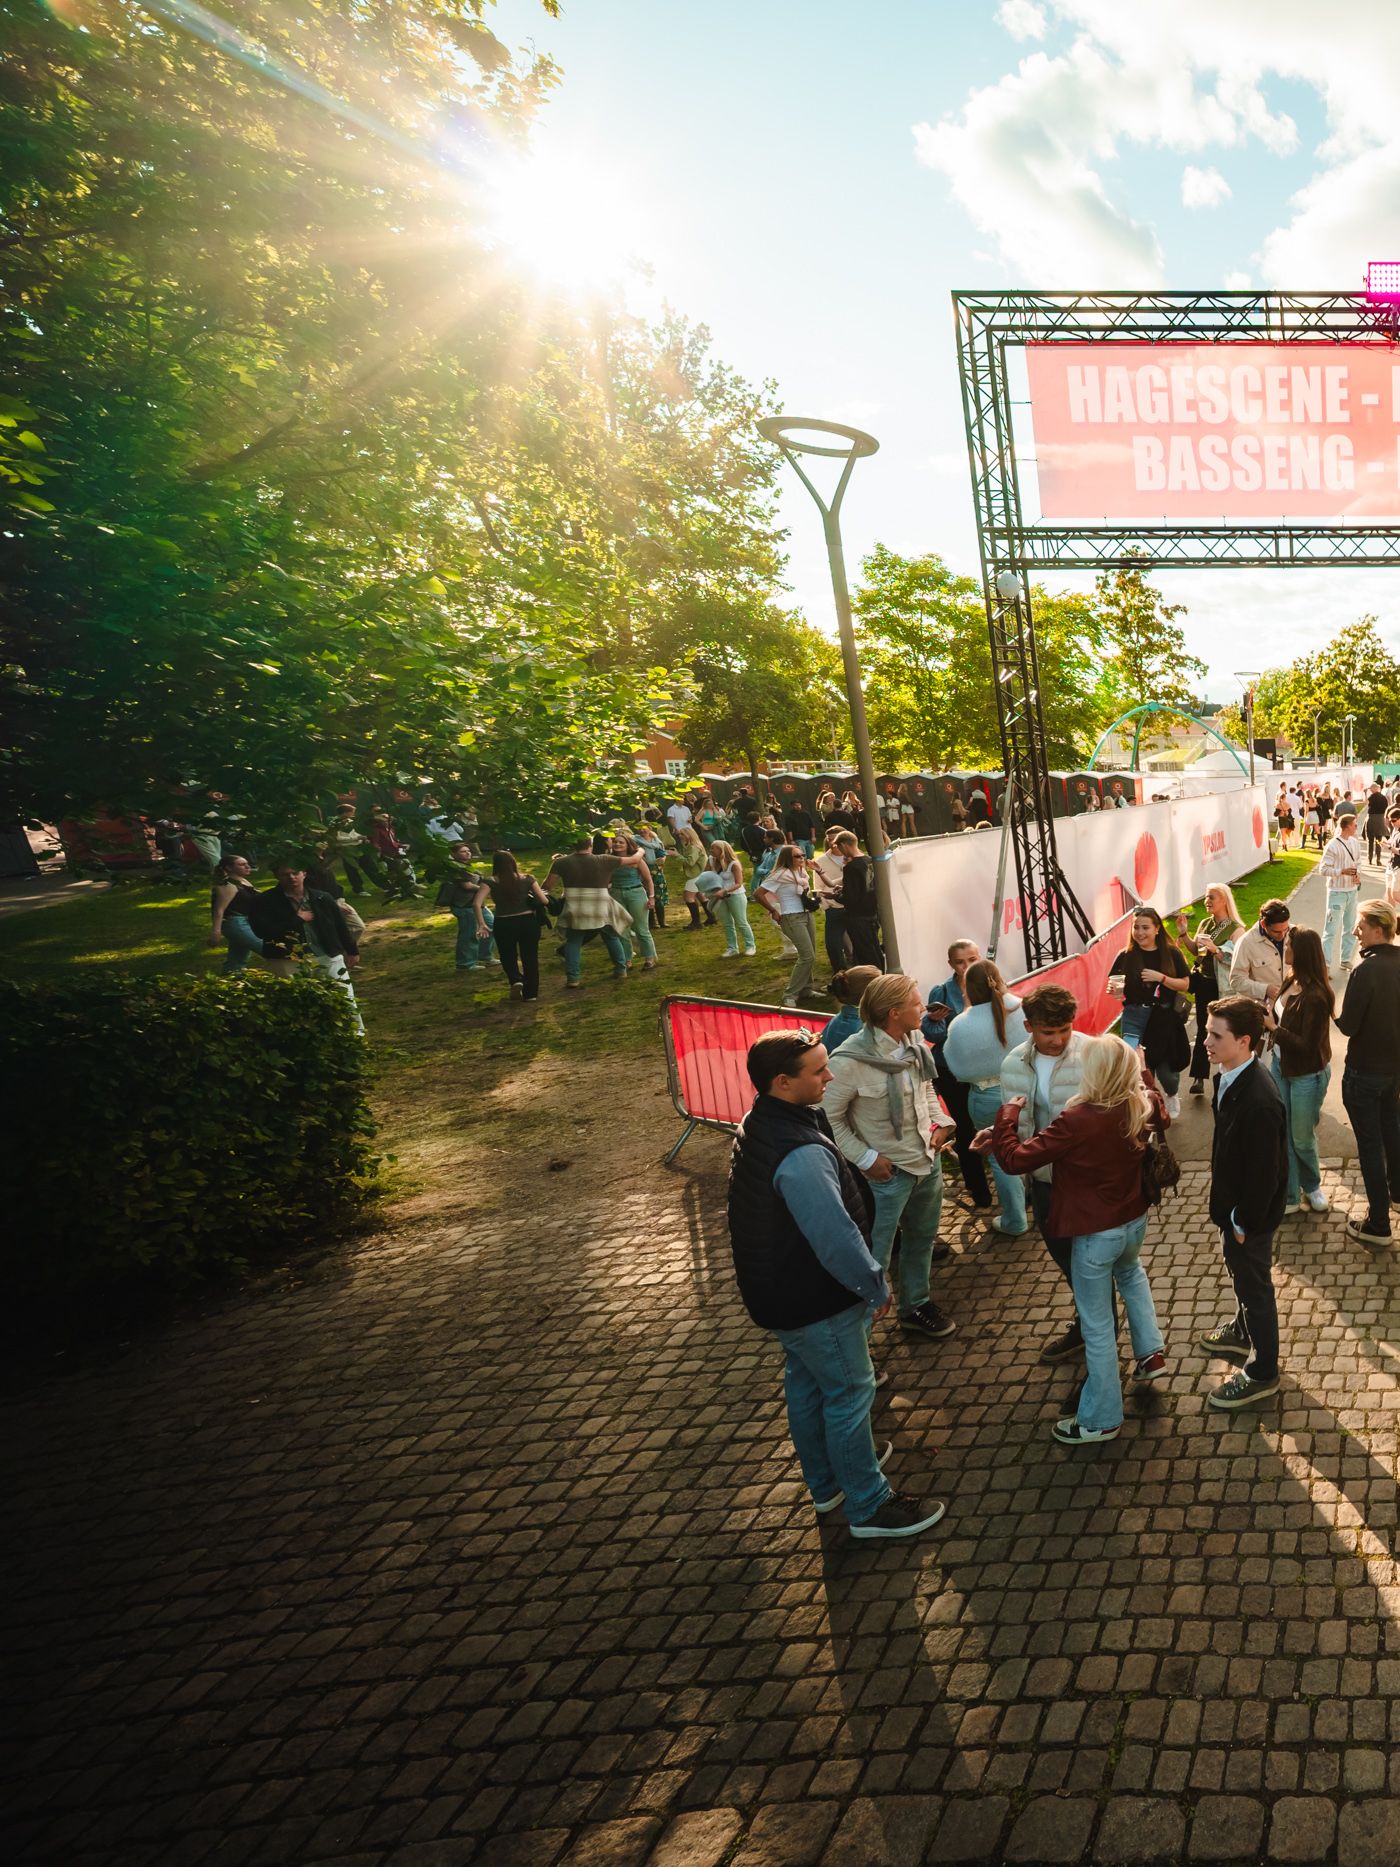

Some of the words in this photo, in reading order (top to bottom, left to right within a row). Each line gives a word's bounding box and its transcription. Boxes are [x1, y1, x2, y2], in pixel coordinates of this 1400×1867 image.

[1067, 365, 1351, 424] HAGESCENE
[1361, 394, 1379, 405] -
[1132, 434, 1355, 492] BASSENG
[1366, 461, 1384, 473] -
